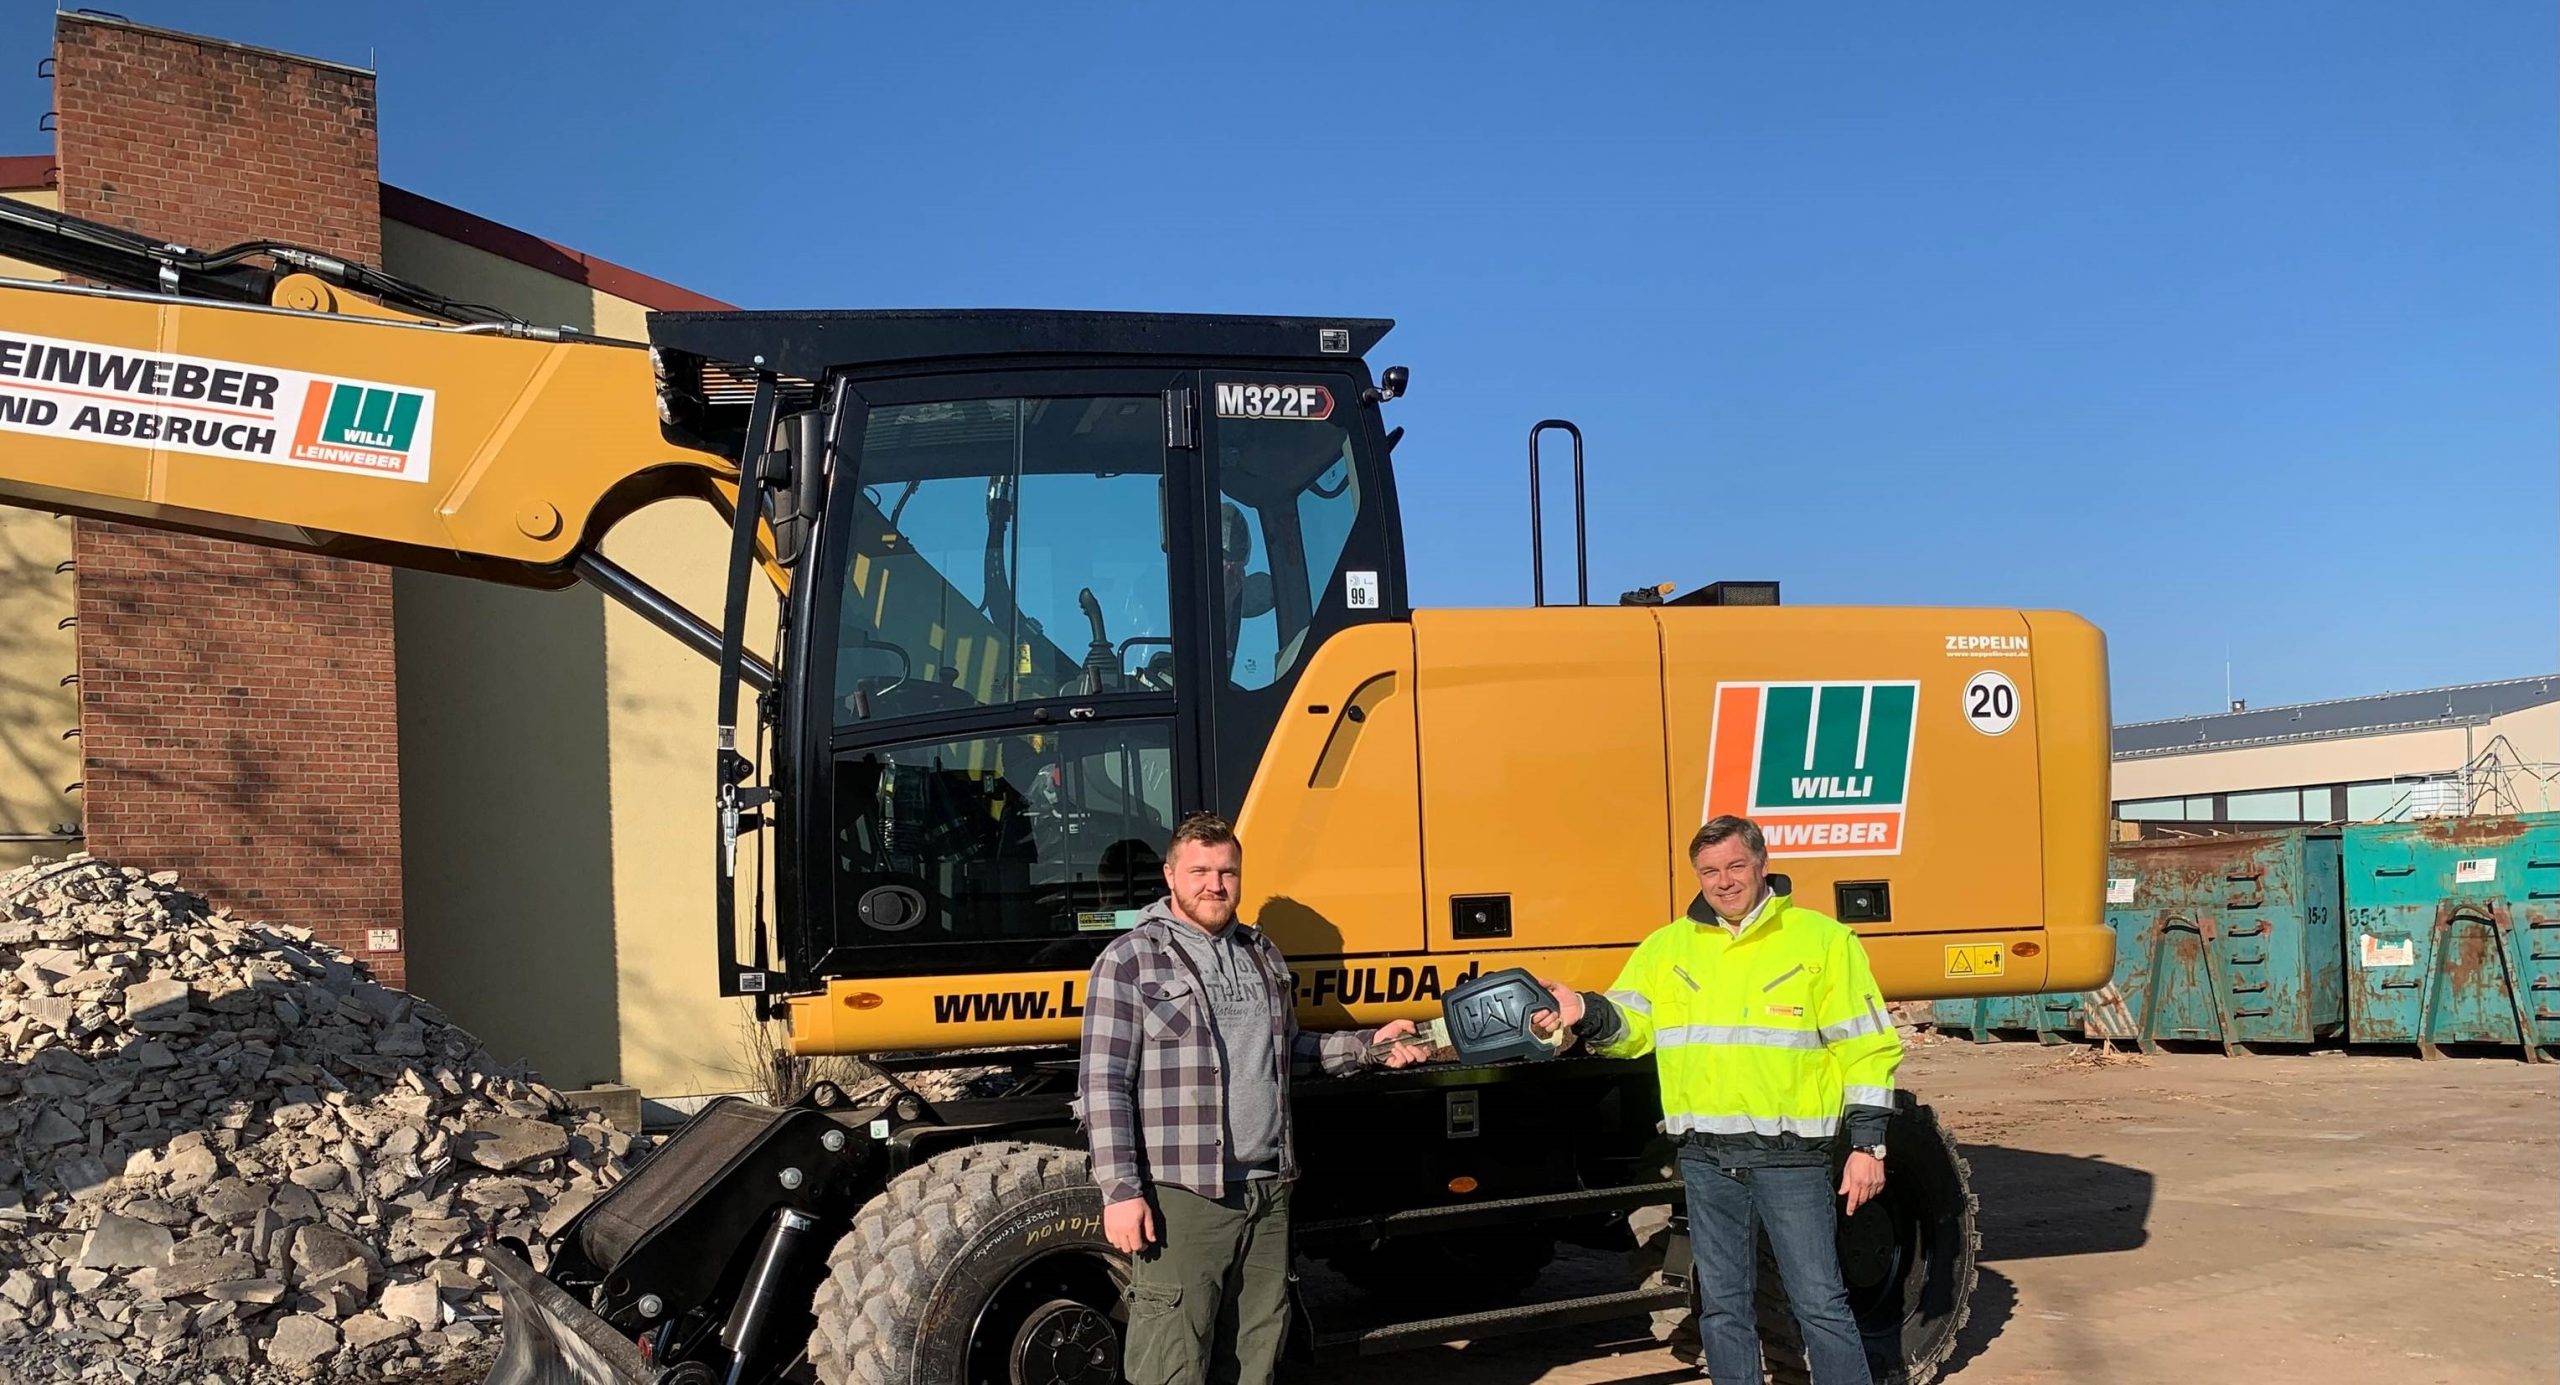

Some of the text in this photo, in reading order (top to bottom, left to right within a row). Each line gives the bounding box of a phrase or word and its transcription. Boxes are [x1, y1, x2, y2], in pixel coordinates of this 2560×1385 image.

[1217, 385, 1316, 417] M322F
[69, 406, 277, 455] ABBRUCH
[344, 428, 395, 448] WILLI
[295, 444, 402, 470] LEINWEBER
[1351, 587, 1365, 605] 99
[1945, 635, 2028, 650] ZEPPELIN
[1970, 684, 2013, 718] 20
[1791, 775, 1874, 799] WILLI
[1758, 821, 1888, 847] NWEBER
[1458, 988, 1518, 1041] CAT
